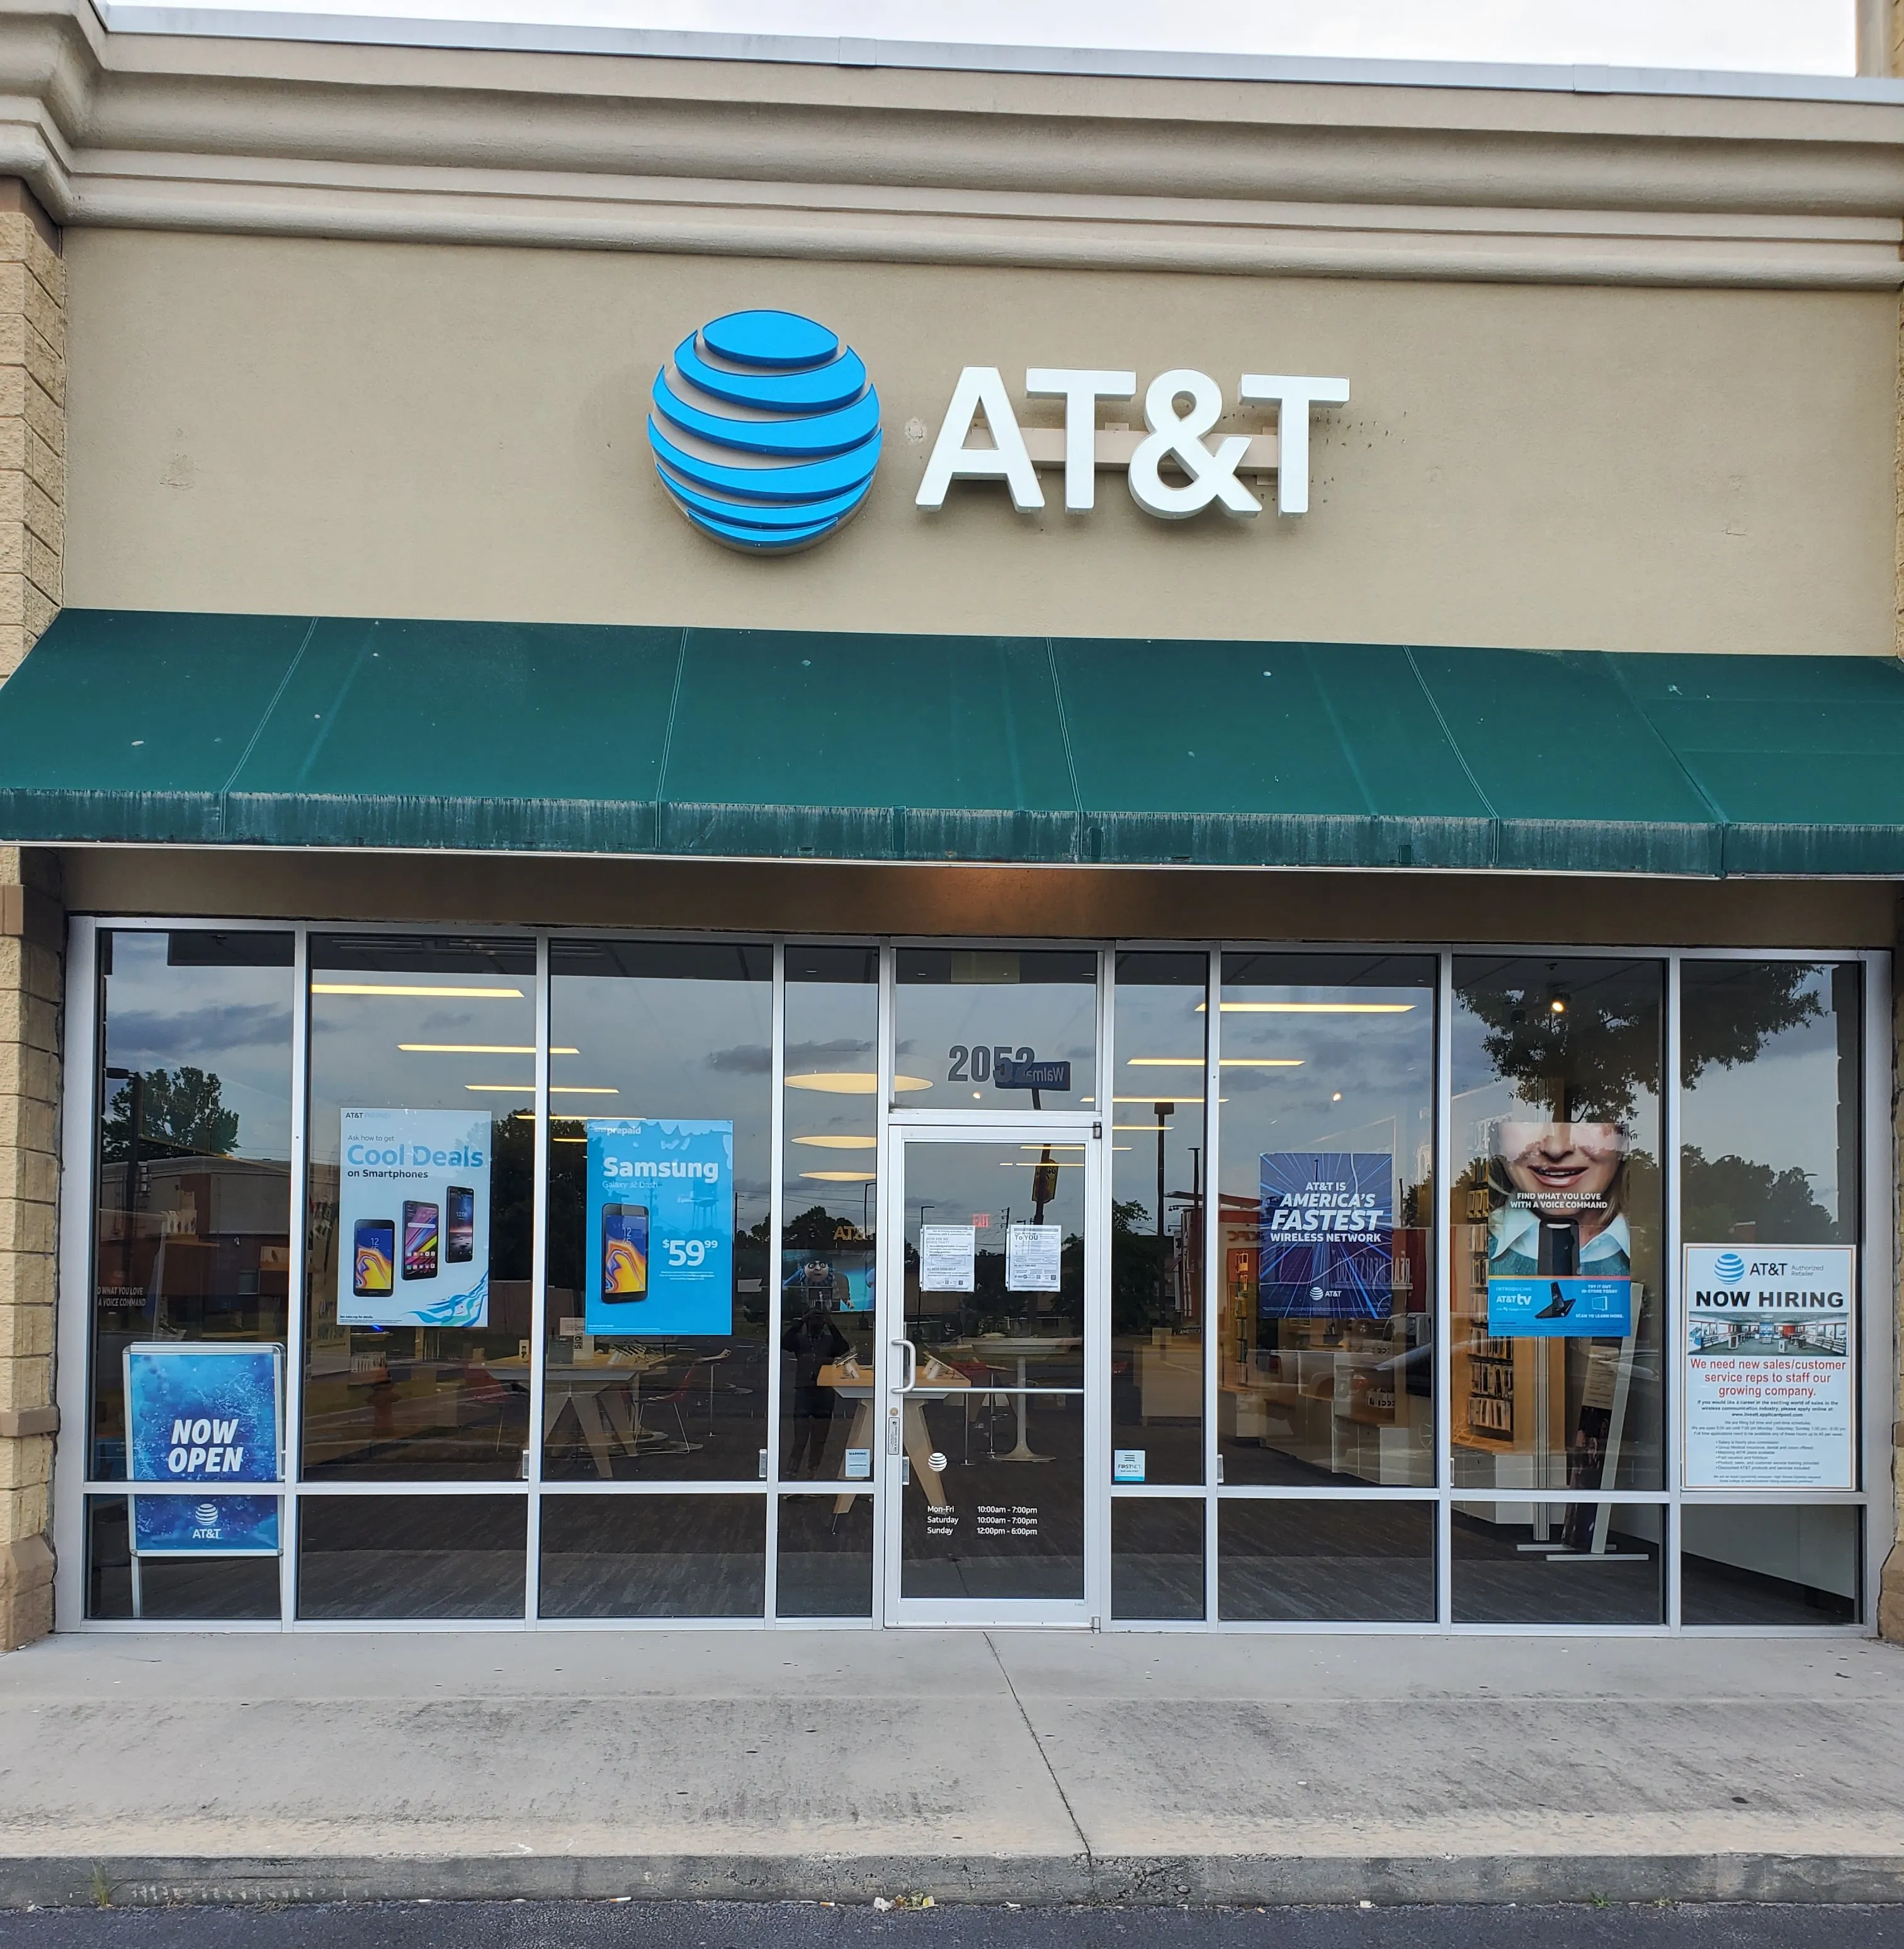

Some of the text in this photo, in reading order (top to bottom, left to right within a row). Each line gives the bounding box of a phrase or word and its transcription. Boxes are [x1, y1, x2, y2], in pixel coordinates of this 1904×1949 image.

[915, 365, 1350, 518] AT&T
[948, 1045, 1035, 1082] 2052
[347, 1144, 484, 1168] Cool Deals
[363, 1169, 429, 1179] Smartphones
[603, 1157, 718, 1184] Samsung
[602, 1180, 628, 1189] Galaxy
[1305, 1182, 1346, 1191] AT&T IS
[1279, 1193, 1376, 1208] AMERICA'S
[1271, 1210, 1384, 1231] FASTEST
[1270, 1233, 1381, 1242] WIRELESS NETWORK
[1749, 1263, 1788, 1276] AT&T
[102, 1287, 117, 1295] WHAT
[118, 1287, 129, 1295] YOU
[130, 1287, 144, 1295] LOVE
[98, 1298, 146, 1307] A VOICE COMMAND
[1517, 1293, 1532, 1305] tv
[1696, 1291, 1844, 1308] NOW HIRING
[1691, 1358, 1846, 1370] We need new sales/customer
[1704, 1372, 1831, 1385] service reps to staff our
[1719, 1386, 1816, 1398] growing company.
[171, 1419, 239, 1445] NOW
[168, 1447, 244, 1473] OPEN
[1012, 1506, 1038, 1514] 7:00pm
[927, 1516, 959, 1525] Saturday
[1012, 1517, 1038, 1525] 7:00pm
[192, 1528, 222, 1539] AT&T
[927, 1527, 953, 1535] Sunday
[977, 1527, 1006, 1535] 12:00pm
[1011, 1528, 1038, 1536] 6:00pm
